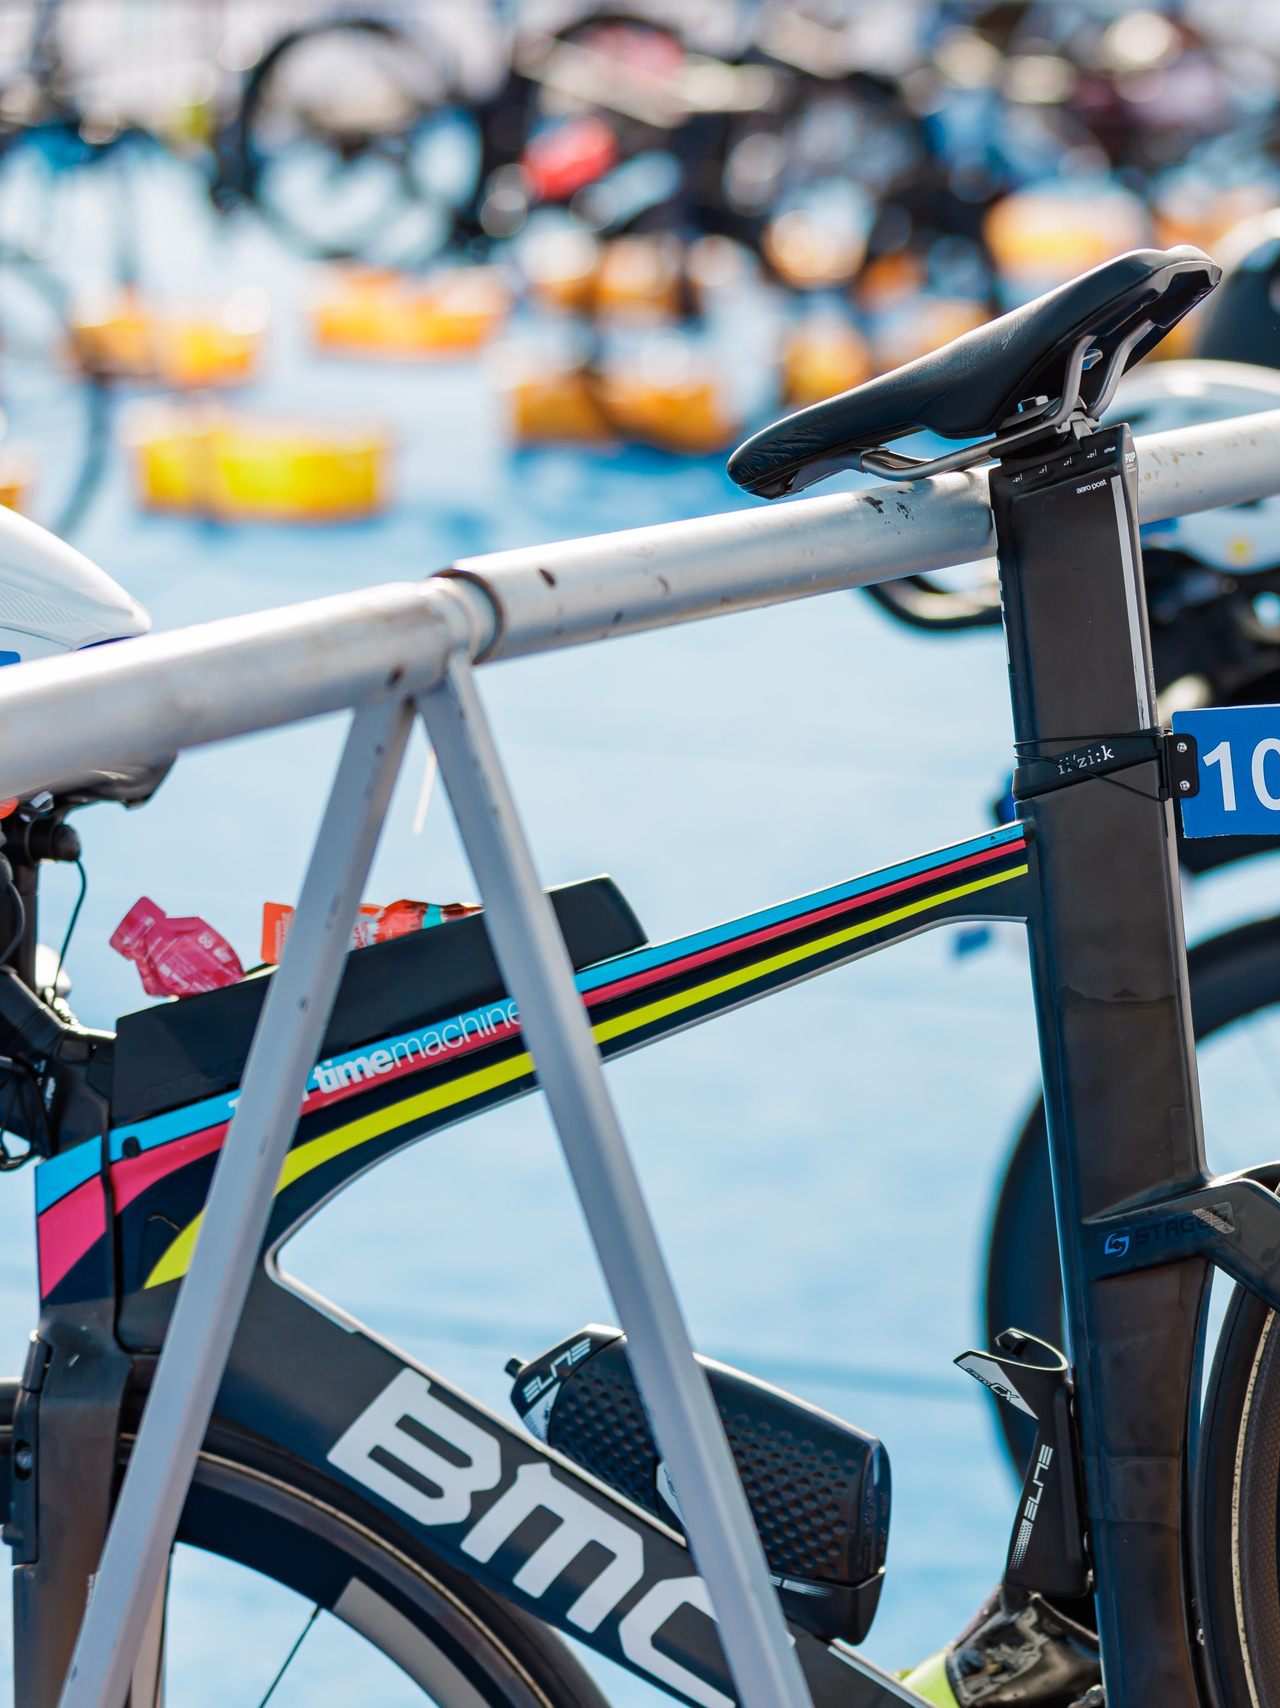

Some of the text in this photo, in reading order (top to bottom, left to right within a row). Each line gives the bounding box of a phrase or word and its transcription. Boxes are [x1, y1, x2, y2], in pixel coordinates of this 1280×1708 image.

[1075, 478, 1108, 495] aero post
[313, 1001, 522, 1094] timemachine
[1134, 1208, 1214, 1245] STAGE
[522, 1337, 591, 1404] ELITE
[989, 1382, 1020, 1402] CX
[1023, 1444, 1053, 1522] ELITE
[326, 1367, 797, 1708] BMC
